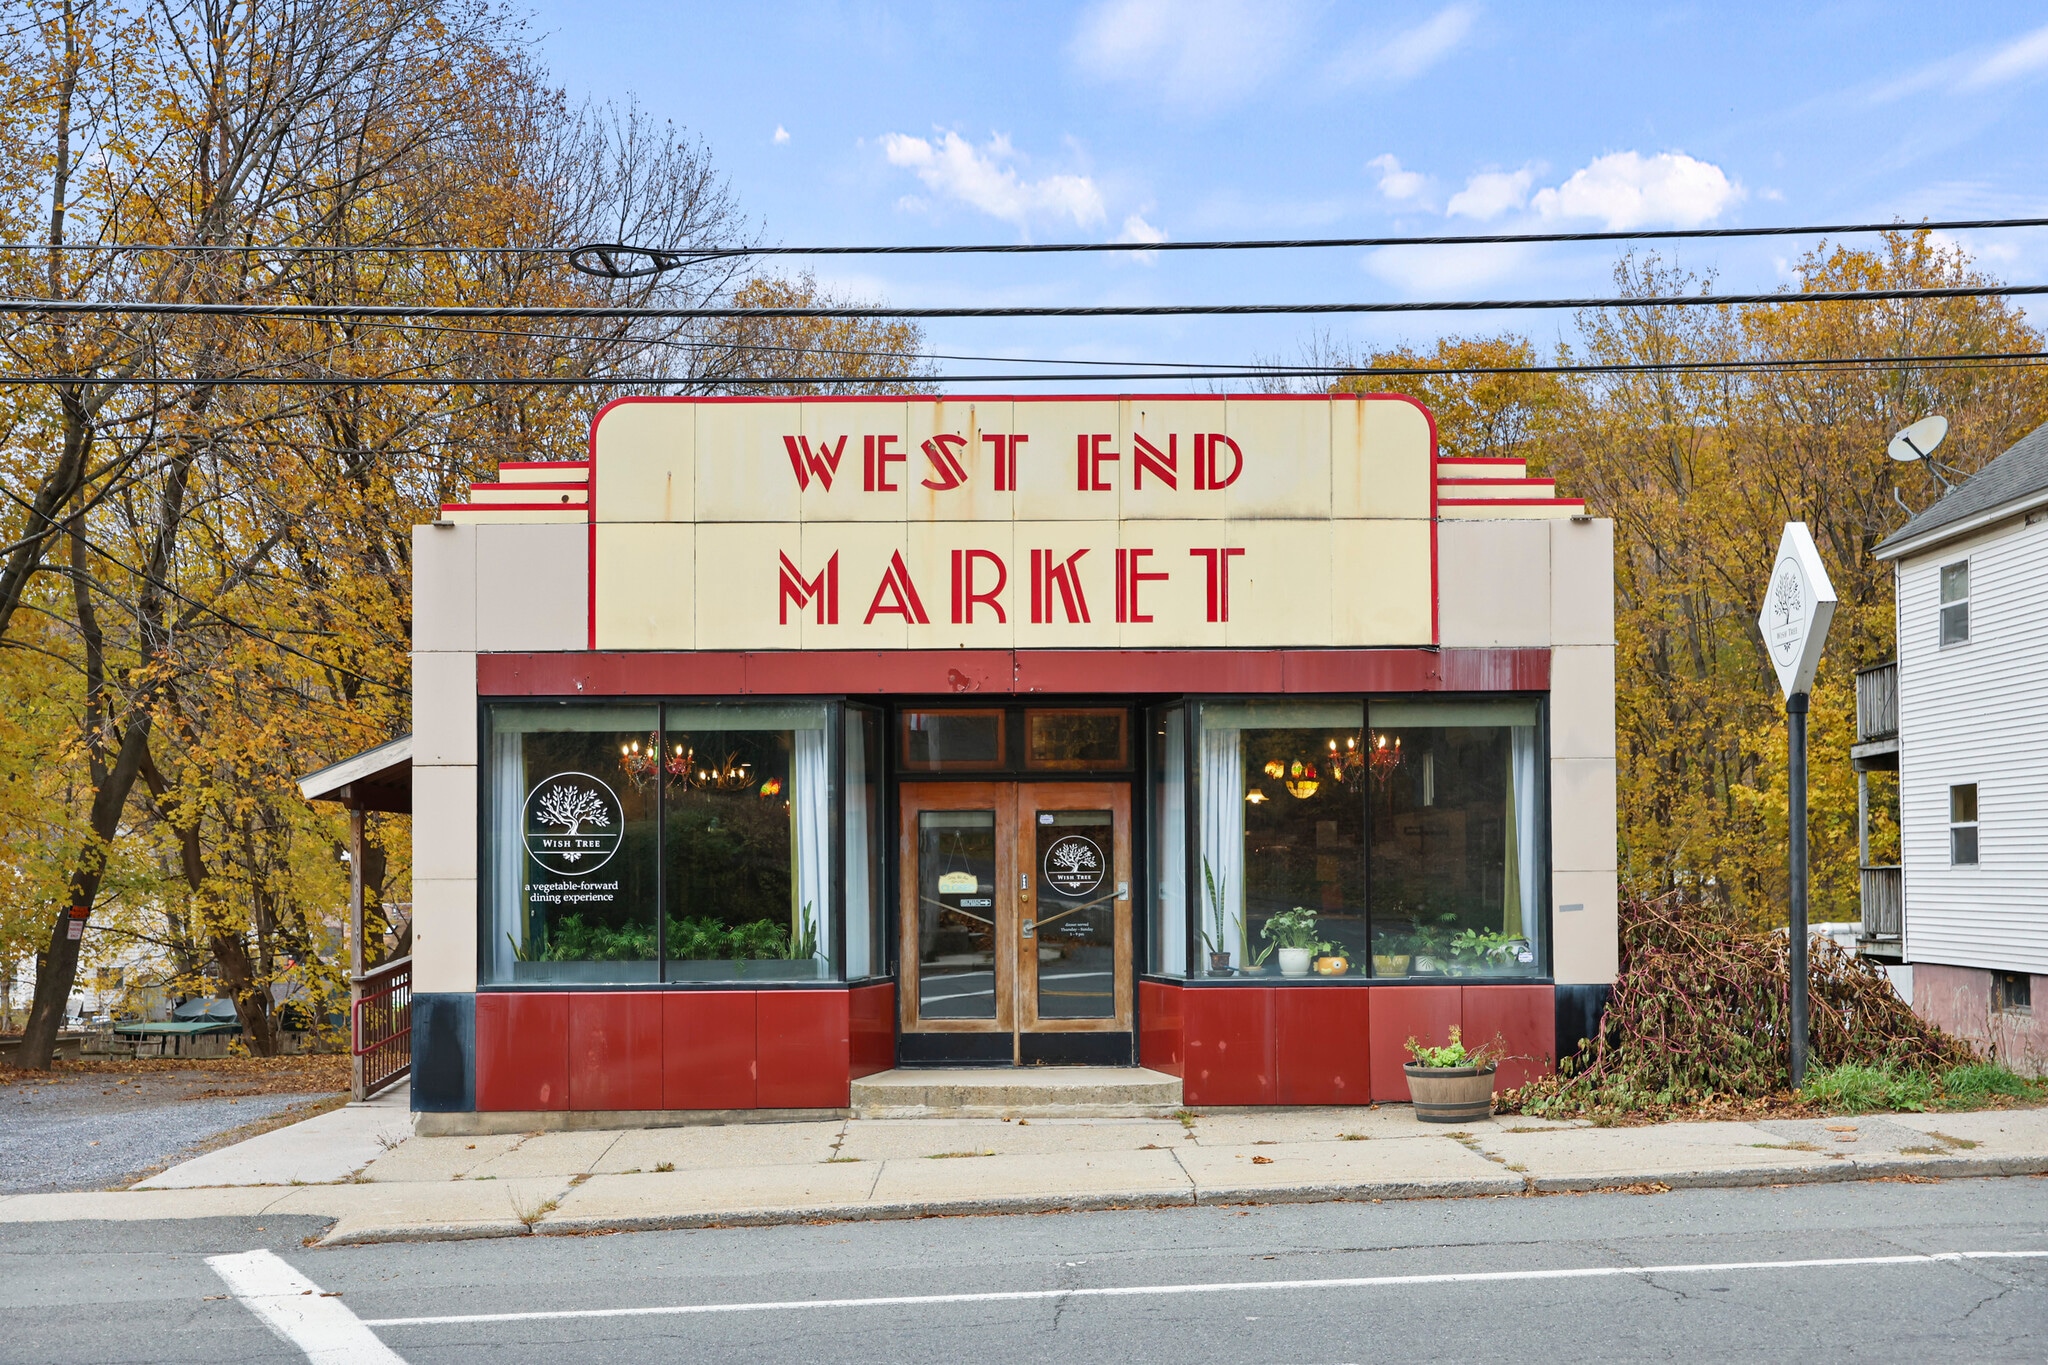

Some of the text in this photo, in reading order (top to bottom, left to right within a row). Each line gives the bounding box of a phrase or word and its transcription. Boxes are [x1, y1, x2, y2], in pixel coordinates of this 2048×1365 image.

[782, 432, 1244, 493] WEST END
[779, 548, 1246, 625] MARKET
[530, 893, 614, 904] dining experience
[533, 881, 619, 893] vegetable-forward
